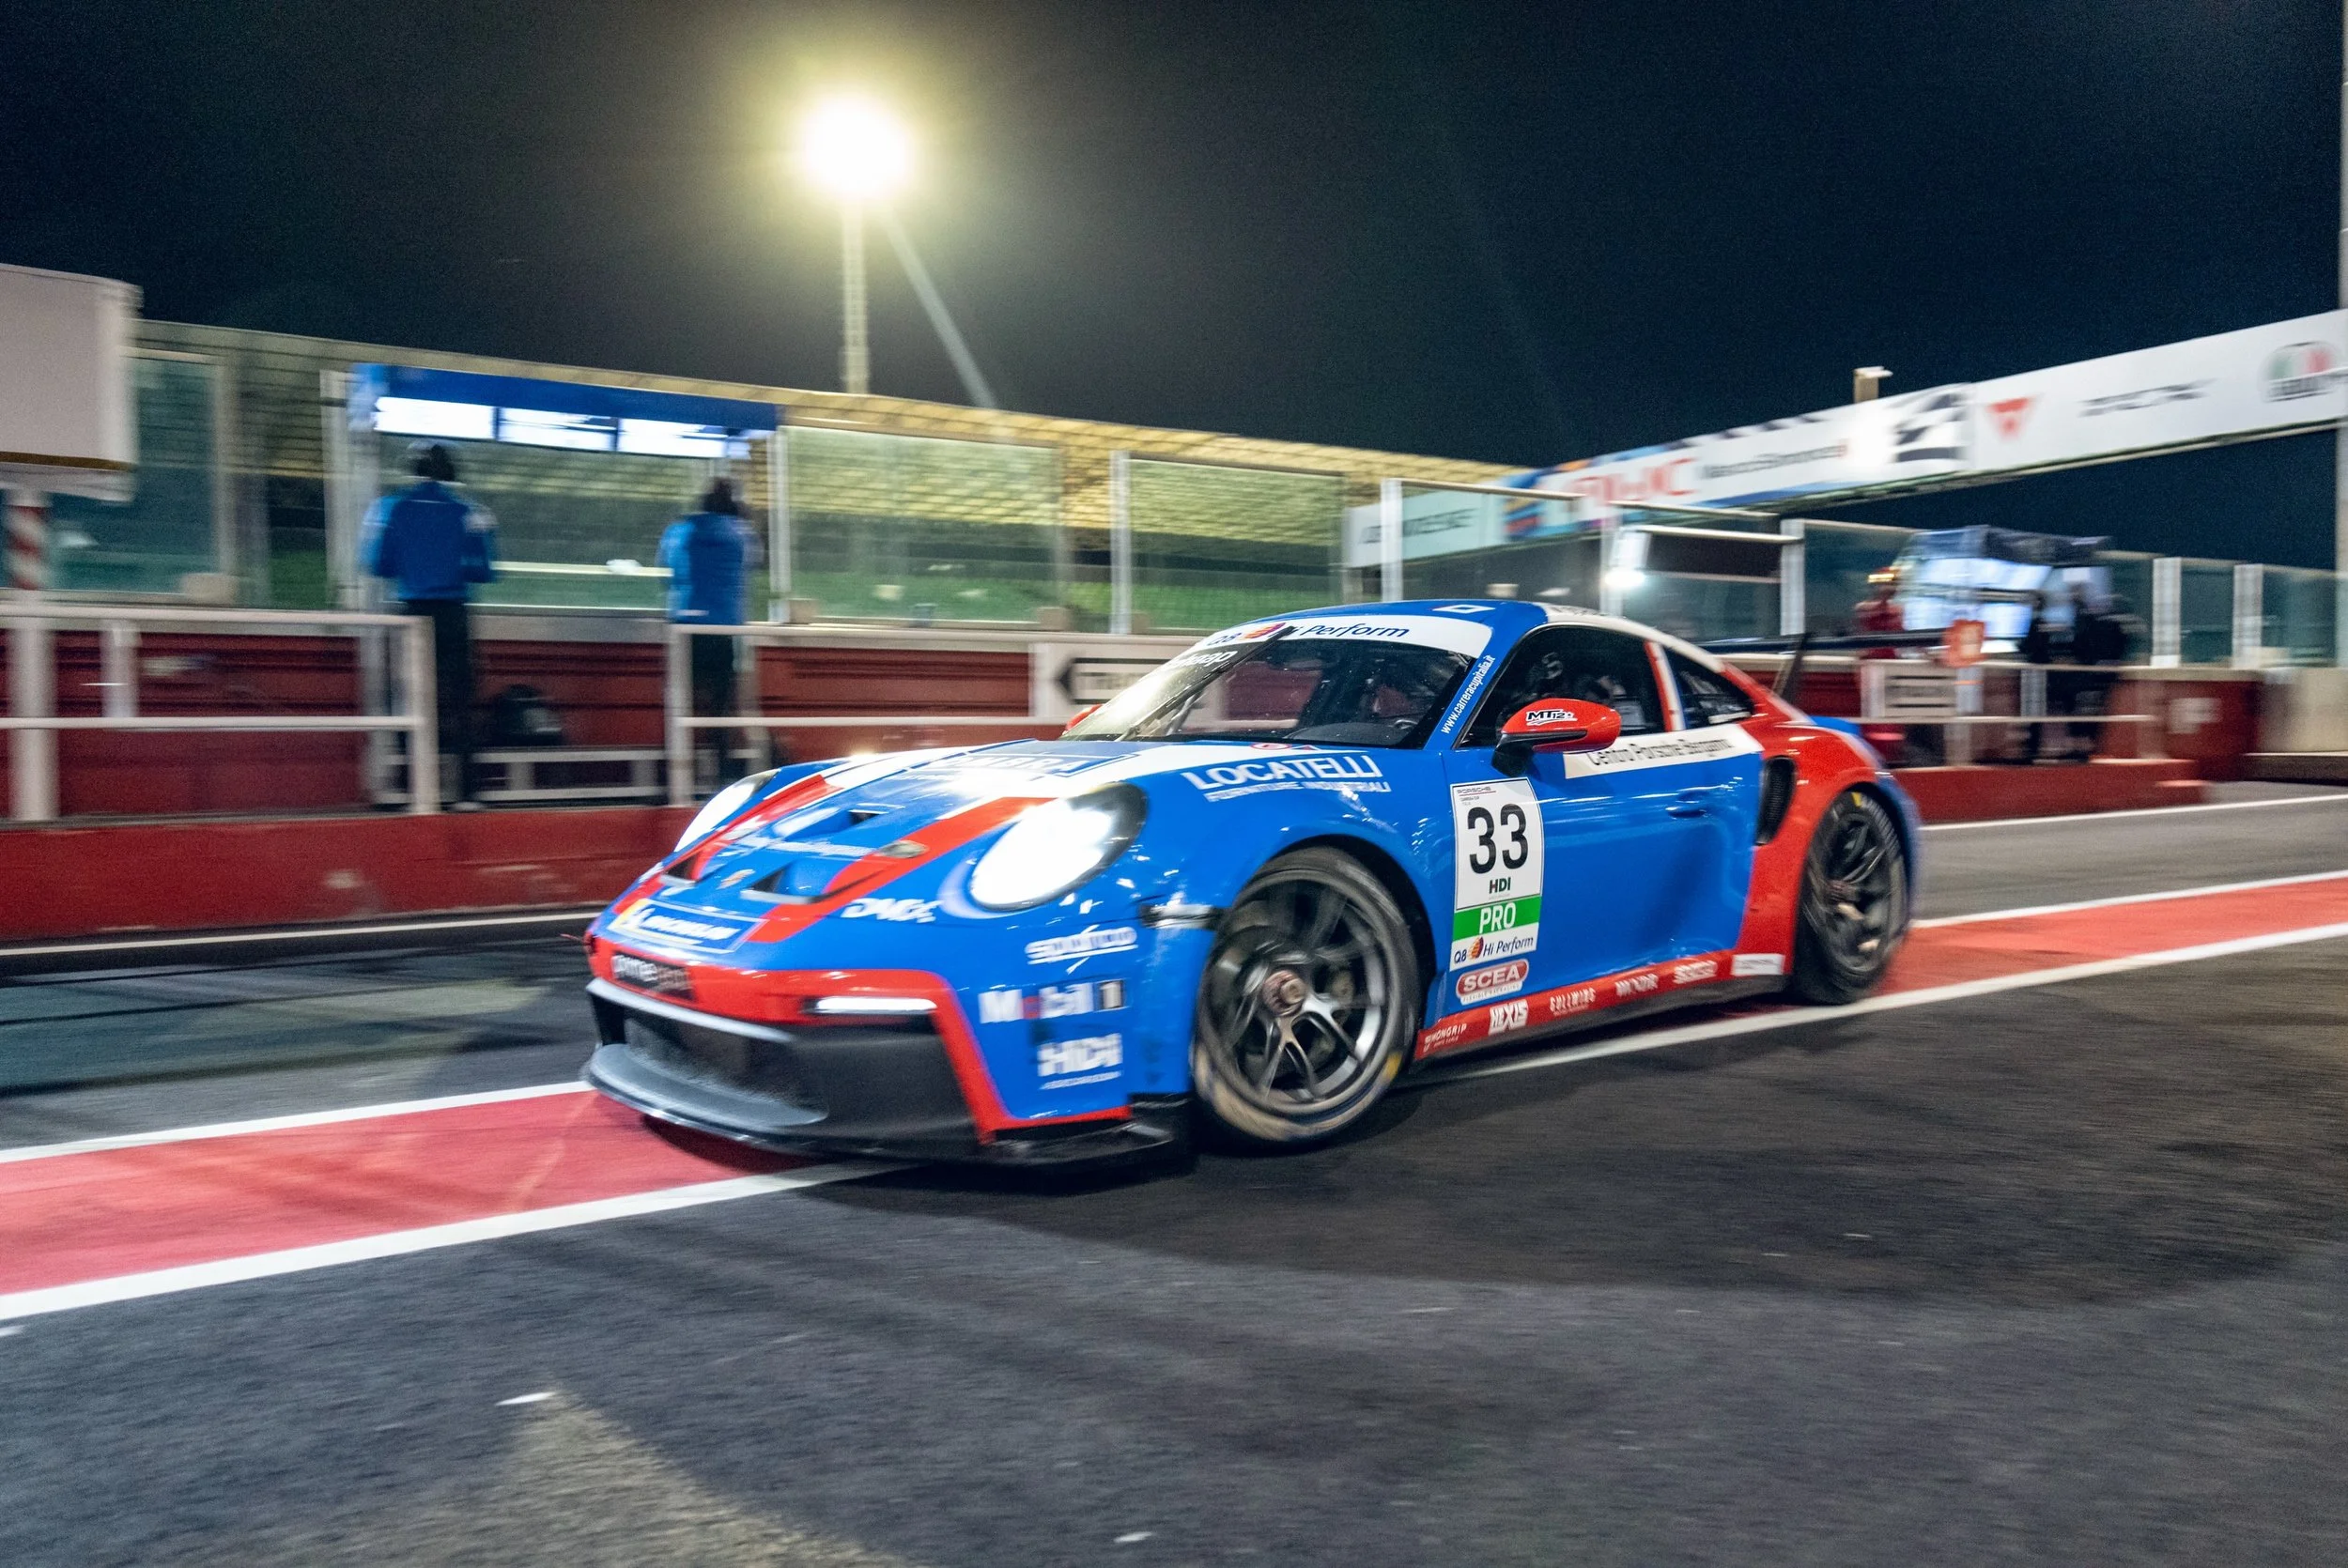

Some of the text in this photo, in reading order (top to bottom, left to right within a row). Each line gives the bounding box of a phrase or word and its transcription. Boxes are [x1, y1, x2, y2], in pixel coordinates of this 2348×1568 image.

[1307, 623, 1410, 638] Perform
[1440, 654, 1496, 734] www.carreracupitalia.it
[1180, 755, 1383, 790] LOCATELLI
[1467, 804, 1529, 874] 33
[1489, 877, 1511, 894] HDI
[1479, 902, 1516, 934] PRO
[1454, 937, 1534, 963] Q8 Hi Perform
[1463, 964, 1521, 992] SCEA
[1489, 999, 1529, 1036] HEXIS
